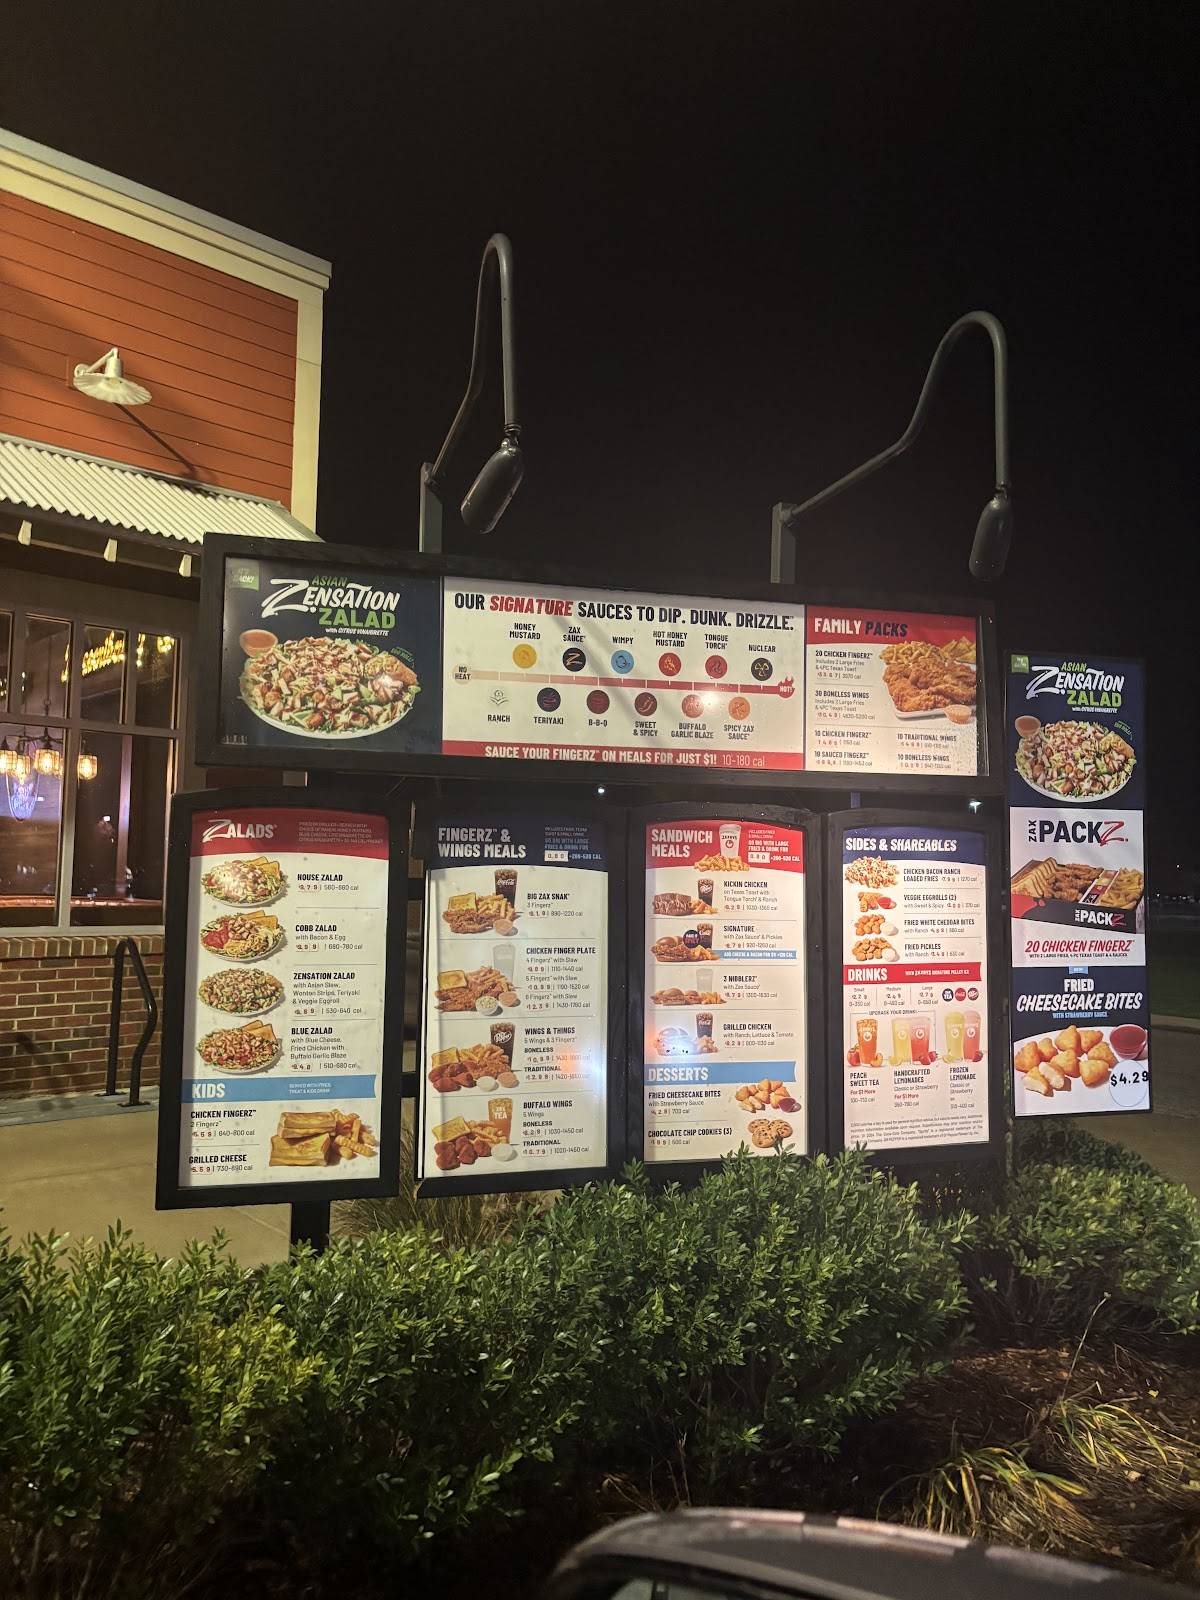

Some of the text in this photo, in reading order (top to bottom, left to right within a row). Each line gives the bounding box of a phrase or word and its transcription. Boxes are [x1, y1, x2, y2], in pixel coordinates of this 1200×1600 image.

[312, 576, 347, 587] ASIAN
[261, 578, 401, 618] ZENSATION
[454, 592, 485, 611] OUR
[489, 595, 574, 616] SIGNATURE
[578, 601, 633, 620] SAUCES
[636, 606, 655, 622] TO
[658, 608, 686, 624] DIP.
[690, 609, 732, 627] DUNK.
[319, 608, 396, 629] ZALAD
[514, 622, 536, 632] HONEY
[568, 626, 581, 635] ZAX
[814, 617, 908, 638] FAMILY PACKS
[509, 630, 541, 640] MUSTARD
[652, 630, 688, 641] HOT HONEY
[704, 634, 729, 642] TONGUE
[612, 636, 634, 645] WIMPY
[655, 639, 685, 648] MUSTARD
[748, 644, 776, 653] NUCLEAR
[458, 666, 468, 674] NO
[1061, 662, 1087, 672] ASIAN
[454, 673, 471, 681] HEAT
[1025, 666, 1125, 700] ZENSATION
[1067, 690, 1122, 707] ZALAD
[487, 714, 511, 723] RANCH
[533, 716, 564, 725] TERIYAKI
[635, 721, 657, 729] SWEET
[678, 723, 707, 731] BUFFALO
[724, 724, 754, 733] SPICY ZAX
[639, 729, 658, 737] SPICY
[671, 730, 714, 739] GARLIC BLAZE
[485, 746, 519, 758] SAUCE
[522, 747, 550, 759] YOUR
[602, 750, 616, 762] ON
[618, 751, 651, 763] MEALS
[654, 752, 674, 764] FOR
[676, 753, 701, 765] JUST
[703, 753, 717, 766] $1!
[722, 754, 750, 766] 10-180
[752, 755, 765, 767] cal
[500, 828, 511, 843] &
[651, 828, 713, 844] SANDWICH
[1029, 820, 1128, 847] ZAX PACKZ
[845, 837, 957, 852] SIDES & SHAREABLES
[438, 843, 481, 858] WINGS
[484, 844, 527, 859] MEALS
[651, 844, 690, 858] MEALS
[297, 873, 343, 882] HOUSE ZALAD
[1081, 911, 1126, 926] PACKZ
[335, 934, 346, 942] Egg
[526, 947, 552, 955] CHICKEN
[553, 947, 575, 955] FINGER
[1025, 941, 1040, 953] 20
[1042, 941, 1088, 953] CHICKEN
[293, 972, 355, 980] ZENSATION ZALAD
[847, 967, 888, 982] DRINKS
[1064, 979, 1094, 992] FRIED
[1017, 993, 1143, 1012] CHEESECAKE BITES
[291, 1027, 333, 1035] BLUE ZALAD
[648, 1067, 709, 1082] DESSERTS
[894, 1069, 931, 1077] HANDCRAFTED
[894, 1077, 924, 1085] LEMONADES
[1110, 1071, 1149, 1087] $4.29
[191, 1083, 226, 1098] KIDS
[666, 1091, 703, 1099] CHEESECAKE
[190, 1110, 222, 1119] CHICKEN
[648, 1129, 681, 1137] CHOCOLATE
[698, 1128, 722, 1136] COOKIES
[723, 1127, 733, 1135] (3)
[189, 1154, 247, 1164] GRILLED CHEESE
